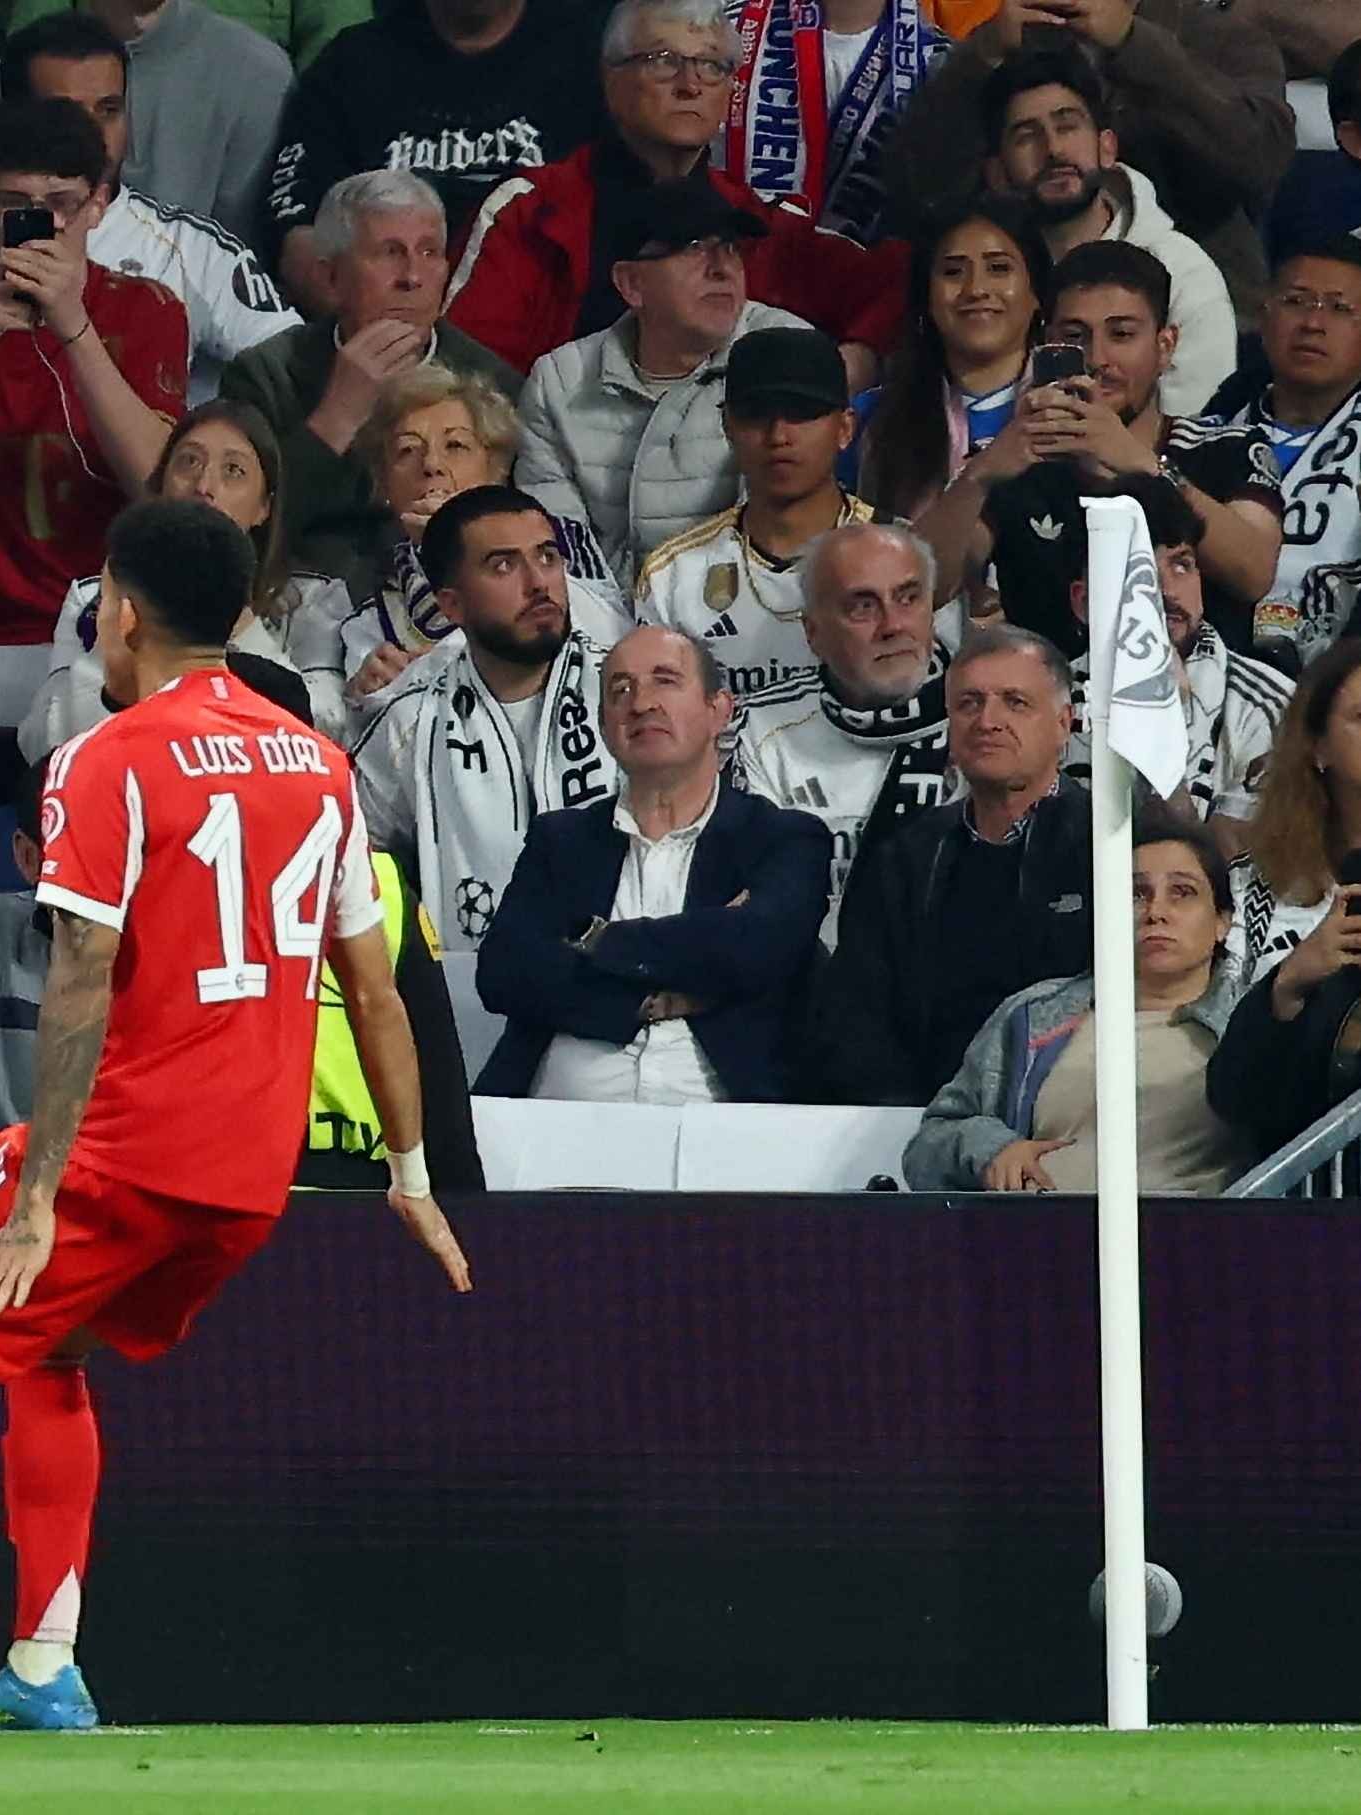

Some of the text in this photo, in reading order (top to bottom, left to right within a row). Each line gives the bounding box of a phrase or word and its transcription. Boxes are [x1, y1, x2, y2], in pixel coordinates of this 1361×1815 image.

[385, 116, 545, 172] Raiders
[1117, 616, 1158, 660] 15
[169, 726, 332, 778] LUIS DÍAZ
[186, 792, 343, 1004] 14
